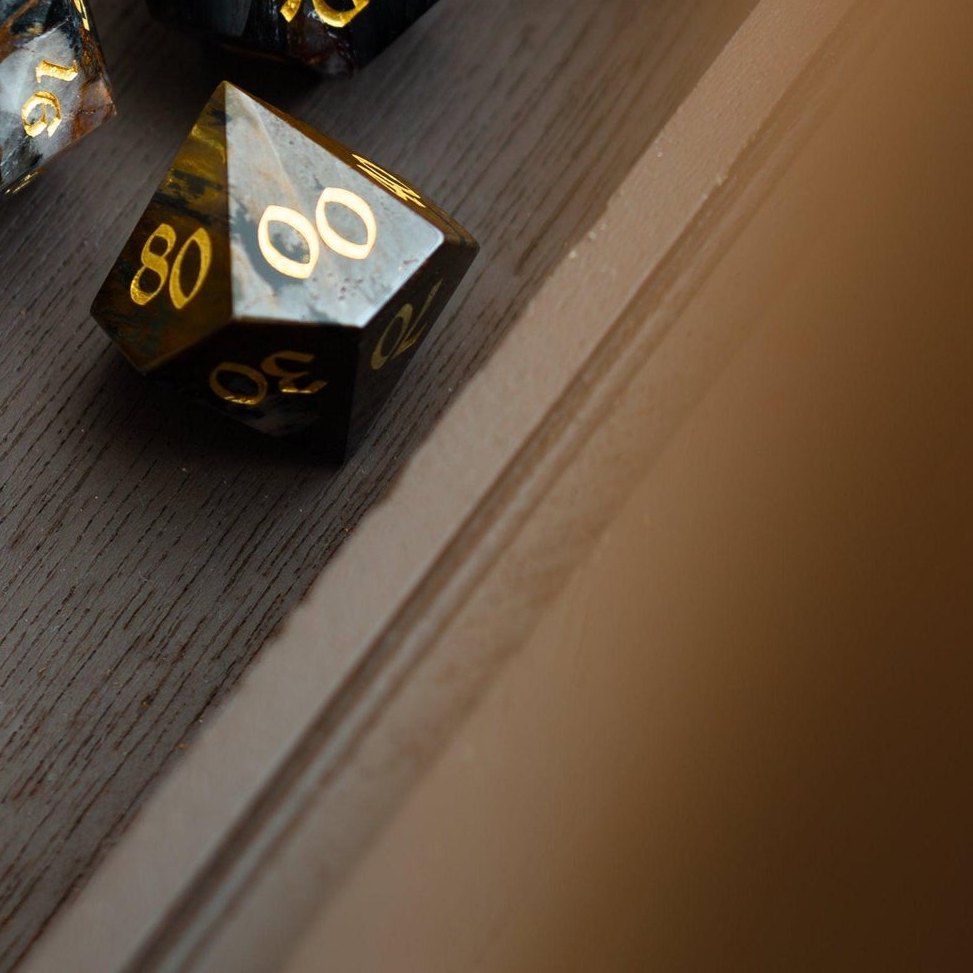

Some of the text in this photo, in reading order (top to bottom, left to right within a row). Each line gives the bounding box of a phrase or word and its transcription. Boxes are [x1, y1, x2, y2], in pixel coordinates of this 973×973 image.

[21, 59, 79, 139] 16
[129, 223, 213, 310] 80
[257, 186, 378, 280] 00
[209, 350, 328, 406] 30
